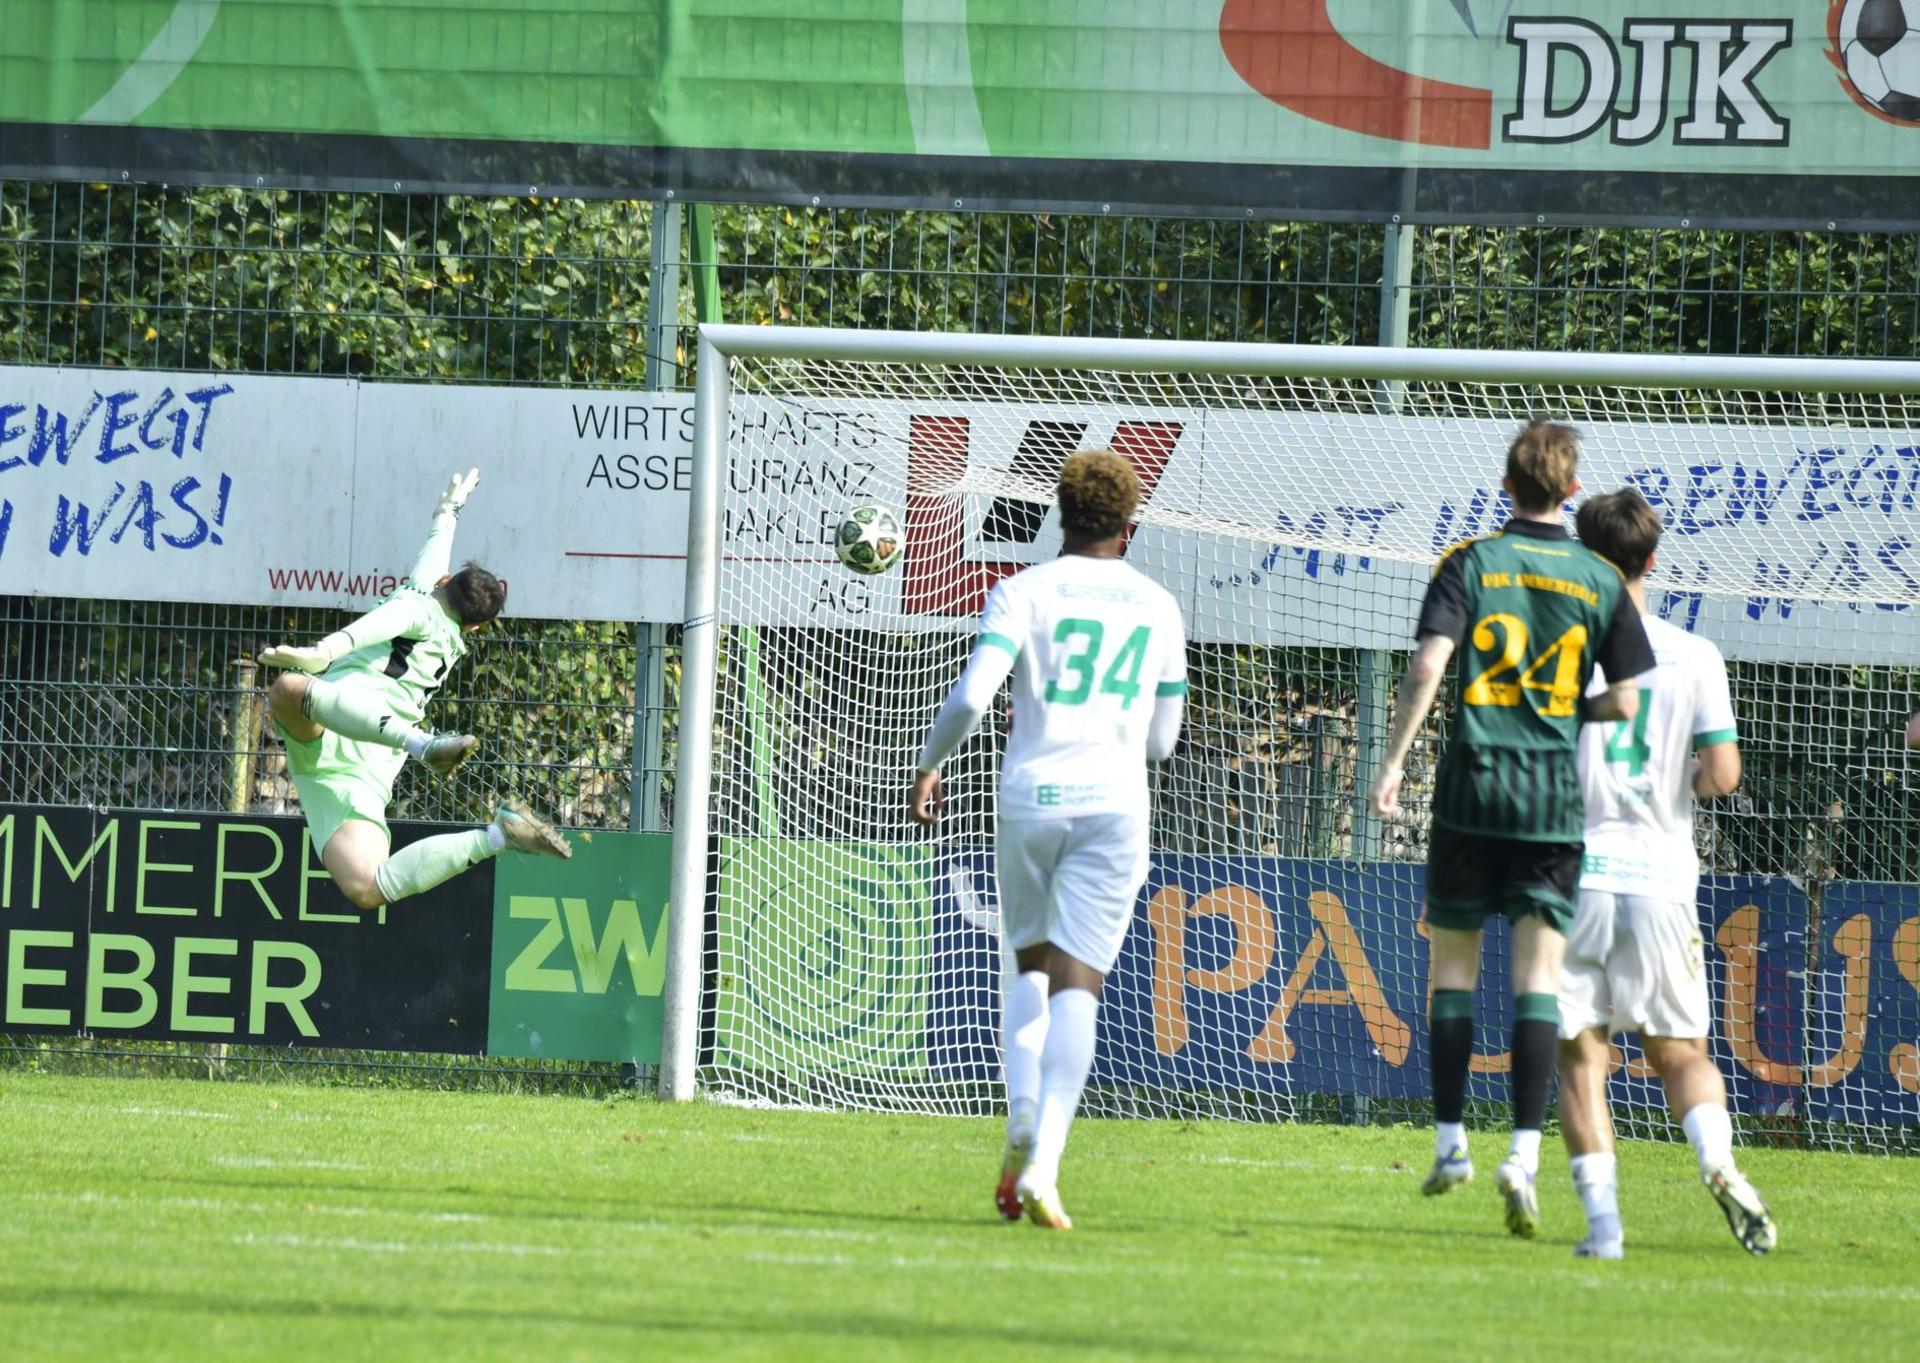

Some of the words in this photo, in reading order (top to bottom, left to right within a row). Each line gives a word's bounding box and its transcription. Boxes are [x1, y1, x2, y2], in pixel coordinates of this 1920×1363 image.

[1502, 16, 1793, 148] DJK
[572, 404, 878, 448] WIRTSHAFTS
[49, 472, 232, 557] WAS!
[586, 454, 876, 499] ASSEURANZ
[810, 579, 870, 615] AG
[1044, 617, 1153, 711] 34
[1463, 613, 1588, 717] 24
[0, 815, 387, 925] MERE
[6, 929, 322, 1037] EBER
[505, 895, 670, 997] ZW
